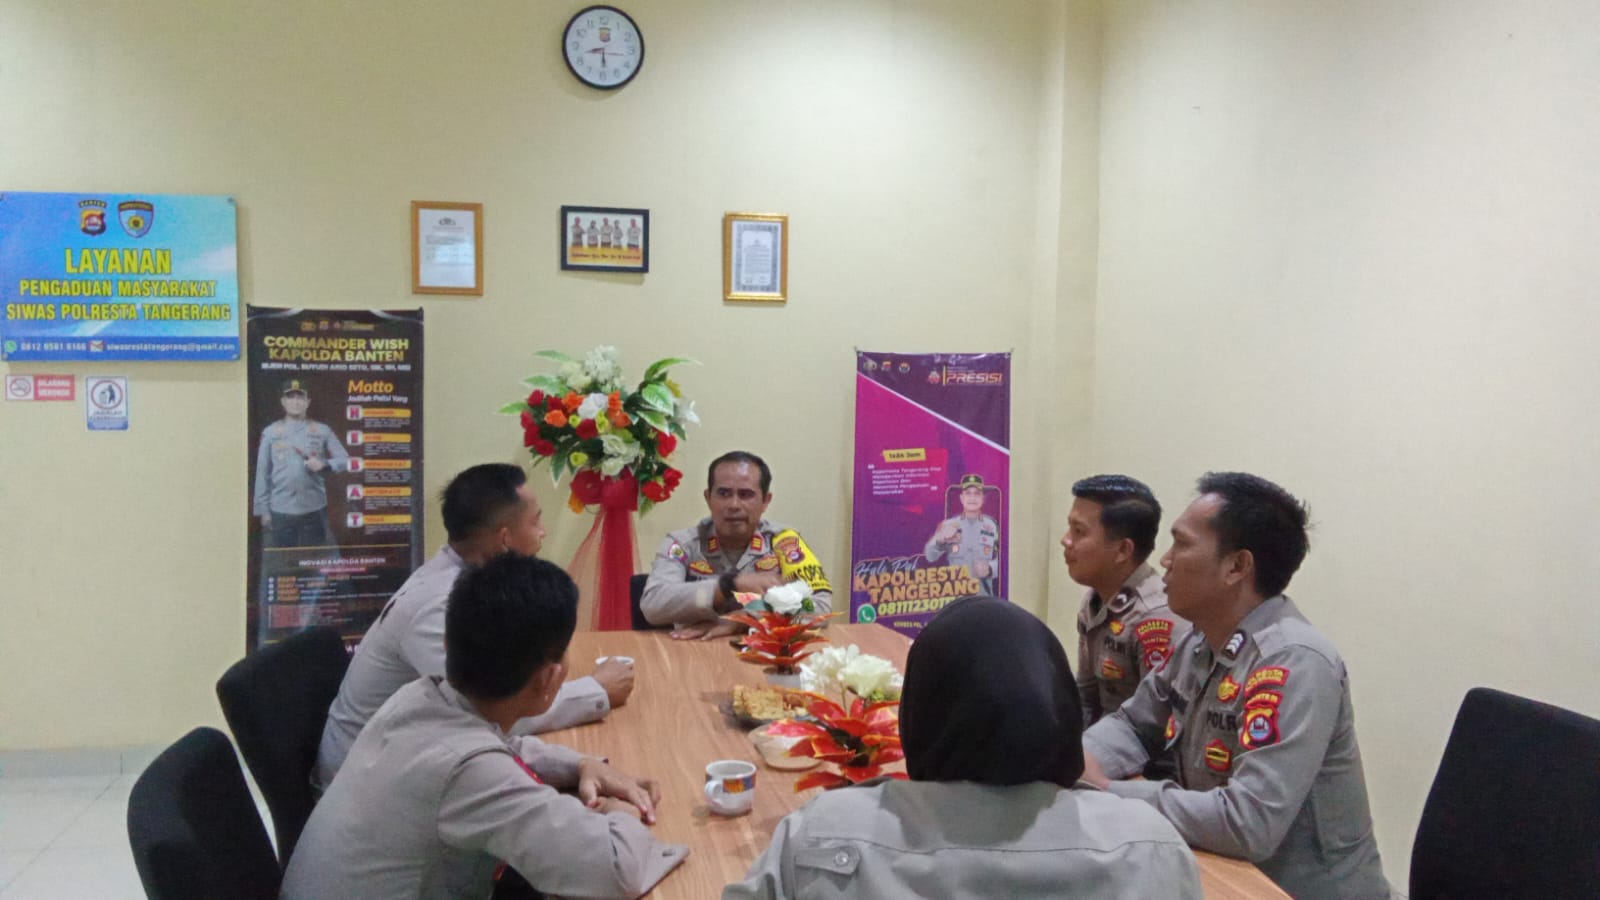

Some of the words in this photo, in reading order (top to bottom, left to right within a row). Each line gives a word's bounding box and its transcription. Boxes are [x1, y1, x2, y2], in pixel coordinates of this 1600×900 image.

[65, 248, 171, 275] LAYANAN
[19, 279, 112, 297] PENGADUAN
[118, 280, 217, 297] MASYARAKAT
[6, 303, 55, 320] SIWAS
[61, 303, 137, 320] POLRESTA
[143, 303, 231, 320] TANGERANG
[264, 336, 366, 350] COMMANDER
[370, 338, 409, 350] WISH
[269, 348, 342, 361] KAPOLDA
[345, 350, 404, 362] BANTEN
[947, 372, 1003, 384] PRESISI
[348, 380, 393, 395] Motto
[350, 407, 359, 418] H
[350, 487, 360, 497] A
[351, 514, 359, 526] T
[854, 565, 970, 592] KAPOLRESTA
[868, 579, 980, 604] TANGERANG
